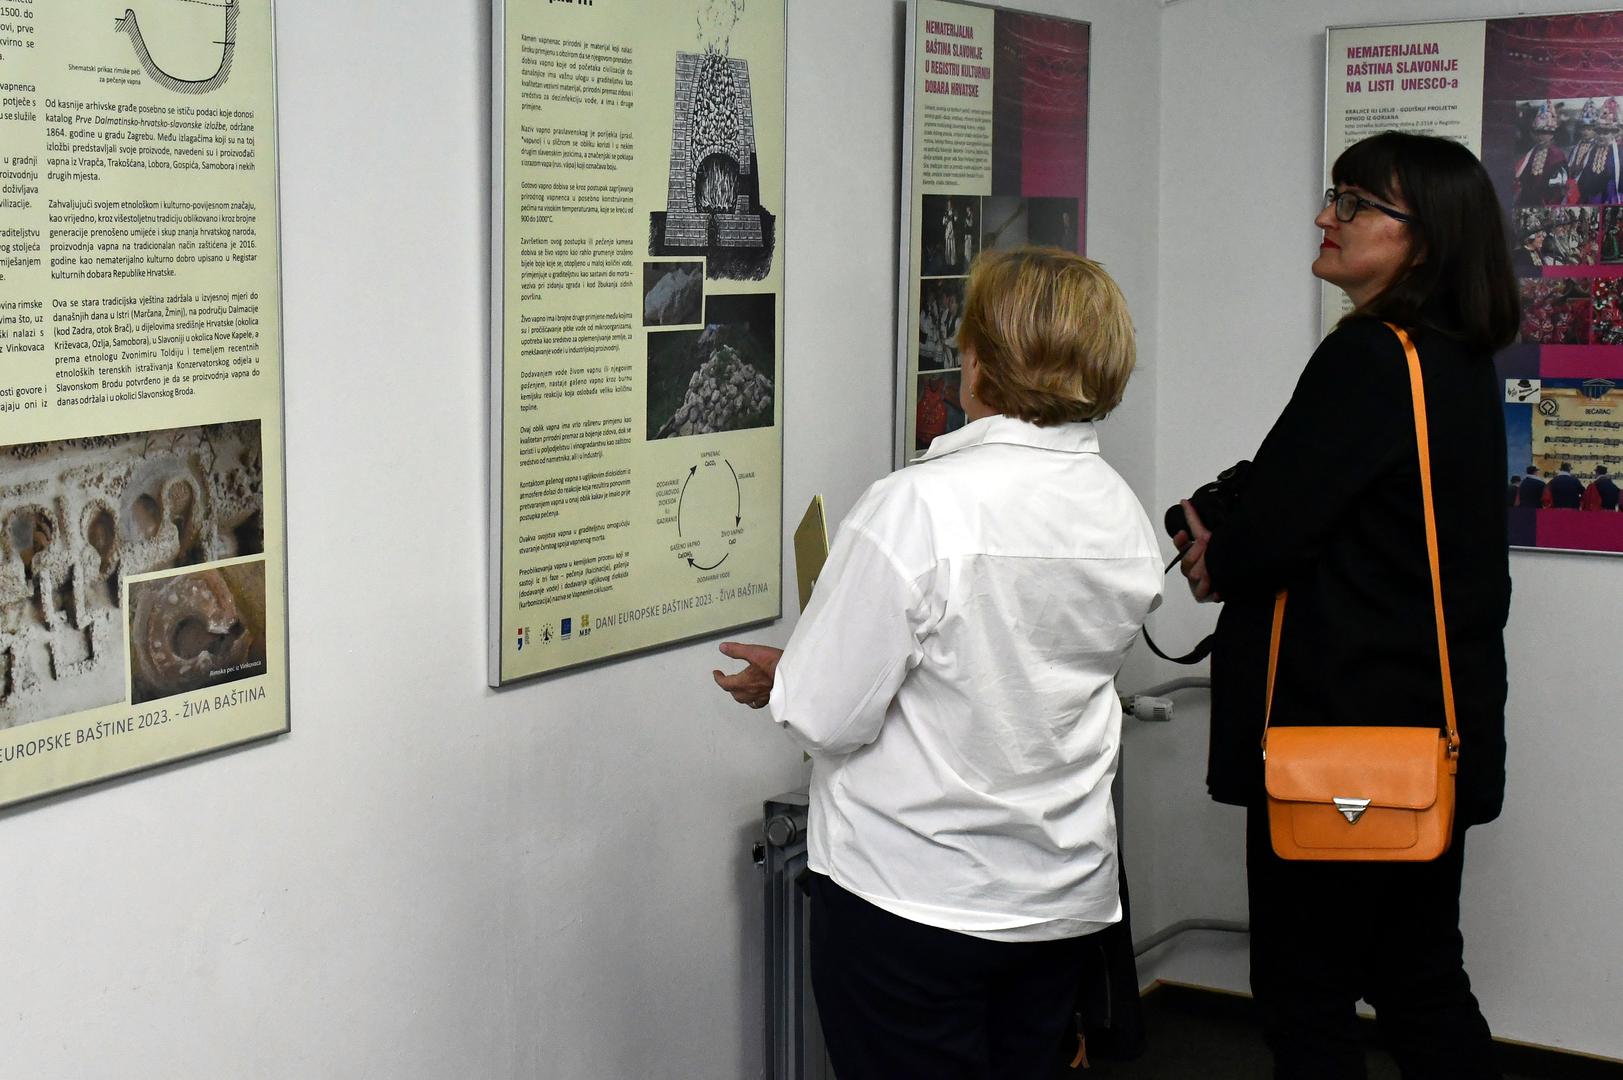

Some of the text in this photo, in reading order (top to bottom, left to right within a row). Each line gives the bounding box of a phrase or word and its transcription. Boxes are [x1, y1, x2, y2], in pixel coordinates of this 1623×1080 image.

[1, 7, 33, 19] 1500. do
[17, 26, 34, 34] prve
[926, 39, 983, 60] BAŠTINA SLAVONIJE
[1348, 43, 1439, 59] NEMATERIJALNA
[931, 61, 960, 76] REGISTRU
[961, 65, 990, 79] KULTURNIH
[1347, 59, 1458, 76] BAŠTINA SLAVONIJE
[925, 80, 979, 98] DOBARA HRVATSKE
[1346, 77, 1458, 93] NA LISTI UNESCO-a
[3, 97, 30, 108] potječe
[45, 99, 56, 108] Od
[58, 99, 84, 111] kasnije
[86, 101, 116, 111] arhivske
[118, 104, 137, 113] građe
[139, 105, 166, 114] posebno
[177, 106, 195, 115] ističu
[196, 108, 218, 117] podaci
[220, 108, 232, 119] koje
[234, 110, 254, 119] donosi
[14, 112, 36, 121] služile
[46, 113, 73, 125] katalog
[76, 115, 92, 124] Prve
[205, 121, 227, 132] izložbe,
[230, 122, 254, 132] održane
[47, 128, 67, 137] 1864.
[70, 129, 95, 139] godine
[105, 131, 125, 141] gradu
[128, 131, 155, 142] Zagrebu.
[158, 133, 177, 142] Među
[179, 134, 213, 144] izlagačima
[215, 135, 226, 145] koji
[246, 137, 255, 146] toj
[12, 156, 37, 166] gradnji
[48, 171, 100, 182] drugih mjesta.
[2, 184, 38, 195] doživljava
[13, 242, 40, 253] stoljeća
[50, 242, 94, 253] proizvodnja
[97, 244, 119, 252] vapna
[134, 241, 175, 250] tradicionalan
[179, 241, 195, 250] način
[199, 240, 228, 249] zaštićena
[231, 241, 236, 250] je
[239, 240, 256, 248] 2016.
[18, 300, 43, 308] rimske
[52, 299, 67, 308] Ova
[102, 296, 137, 307] tradicijska
[139, 296, 164, 306] vještina
[166, 294, 192, 303] zadržala
[202, 293, 229, 303] izvjesnoj
[232, 292, 248, 302] mjeri
[19, 315, 32, 324] što,
[13, 329, 36, 338] nalazi
[6, 343, 44, 352] Vinkovaca
[55, 356, 80, 366] prema
[85, 353, 118, 362] etnologu
[122, 350, 157, 360] Zvonimiru
[161, 348, 184, 358] Toldiju
[193, 346, 225, 355] temeljem
[228, 343, 259, 352] recentnih
[16, 387, 42, 398] govore
[25, 399, 47, 409] oni iz
[596, 615, 616, 629] DANI
[619, 605, 660, 624] EUROPSKE
[662, 597, 693, 614] BAŠTINE
[696, 594, 713, 607] 2023.
[720, 589, 735, 602] ŽIVA
[738, 582, 768, 598] BAŠTINA
[77, 717, 134, 744] BAŠTINE
[138, 710, 171, 729] 2023.
[183, 699, 210, 718] ŽIVA
[215, 686, 266, 710] BAŠTINA
